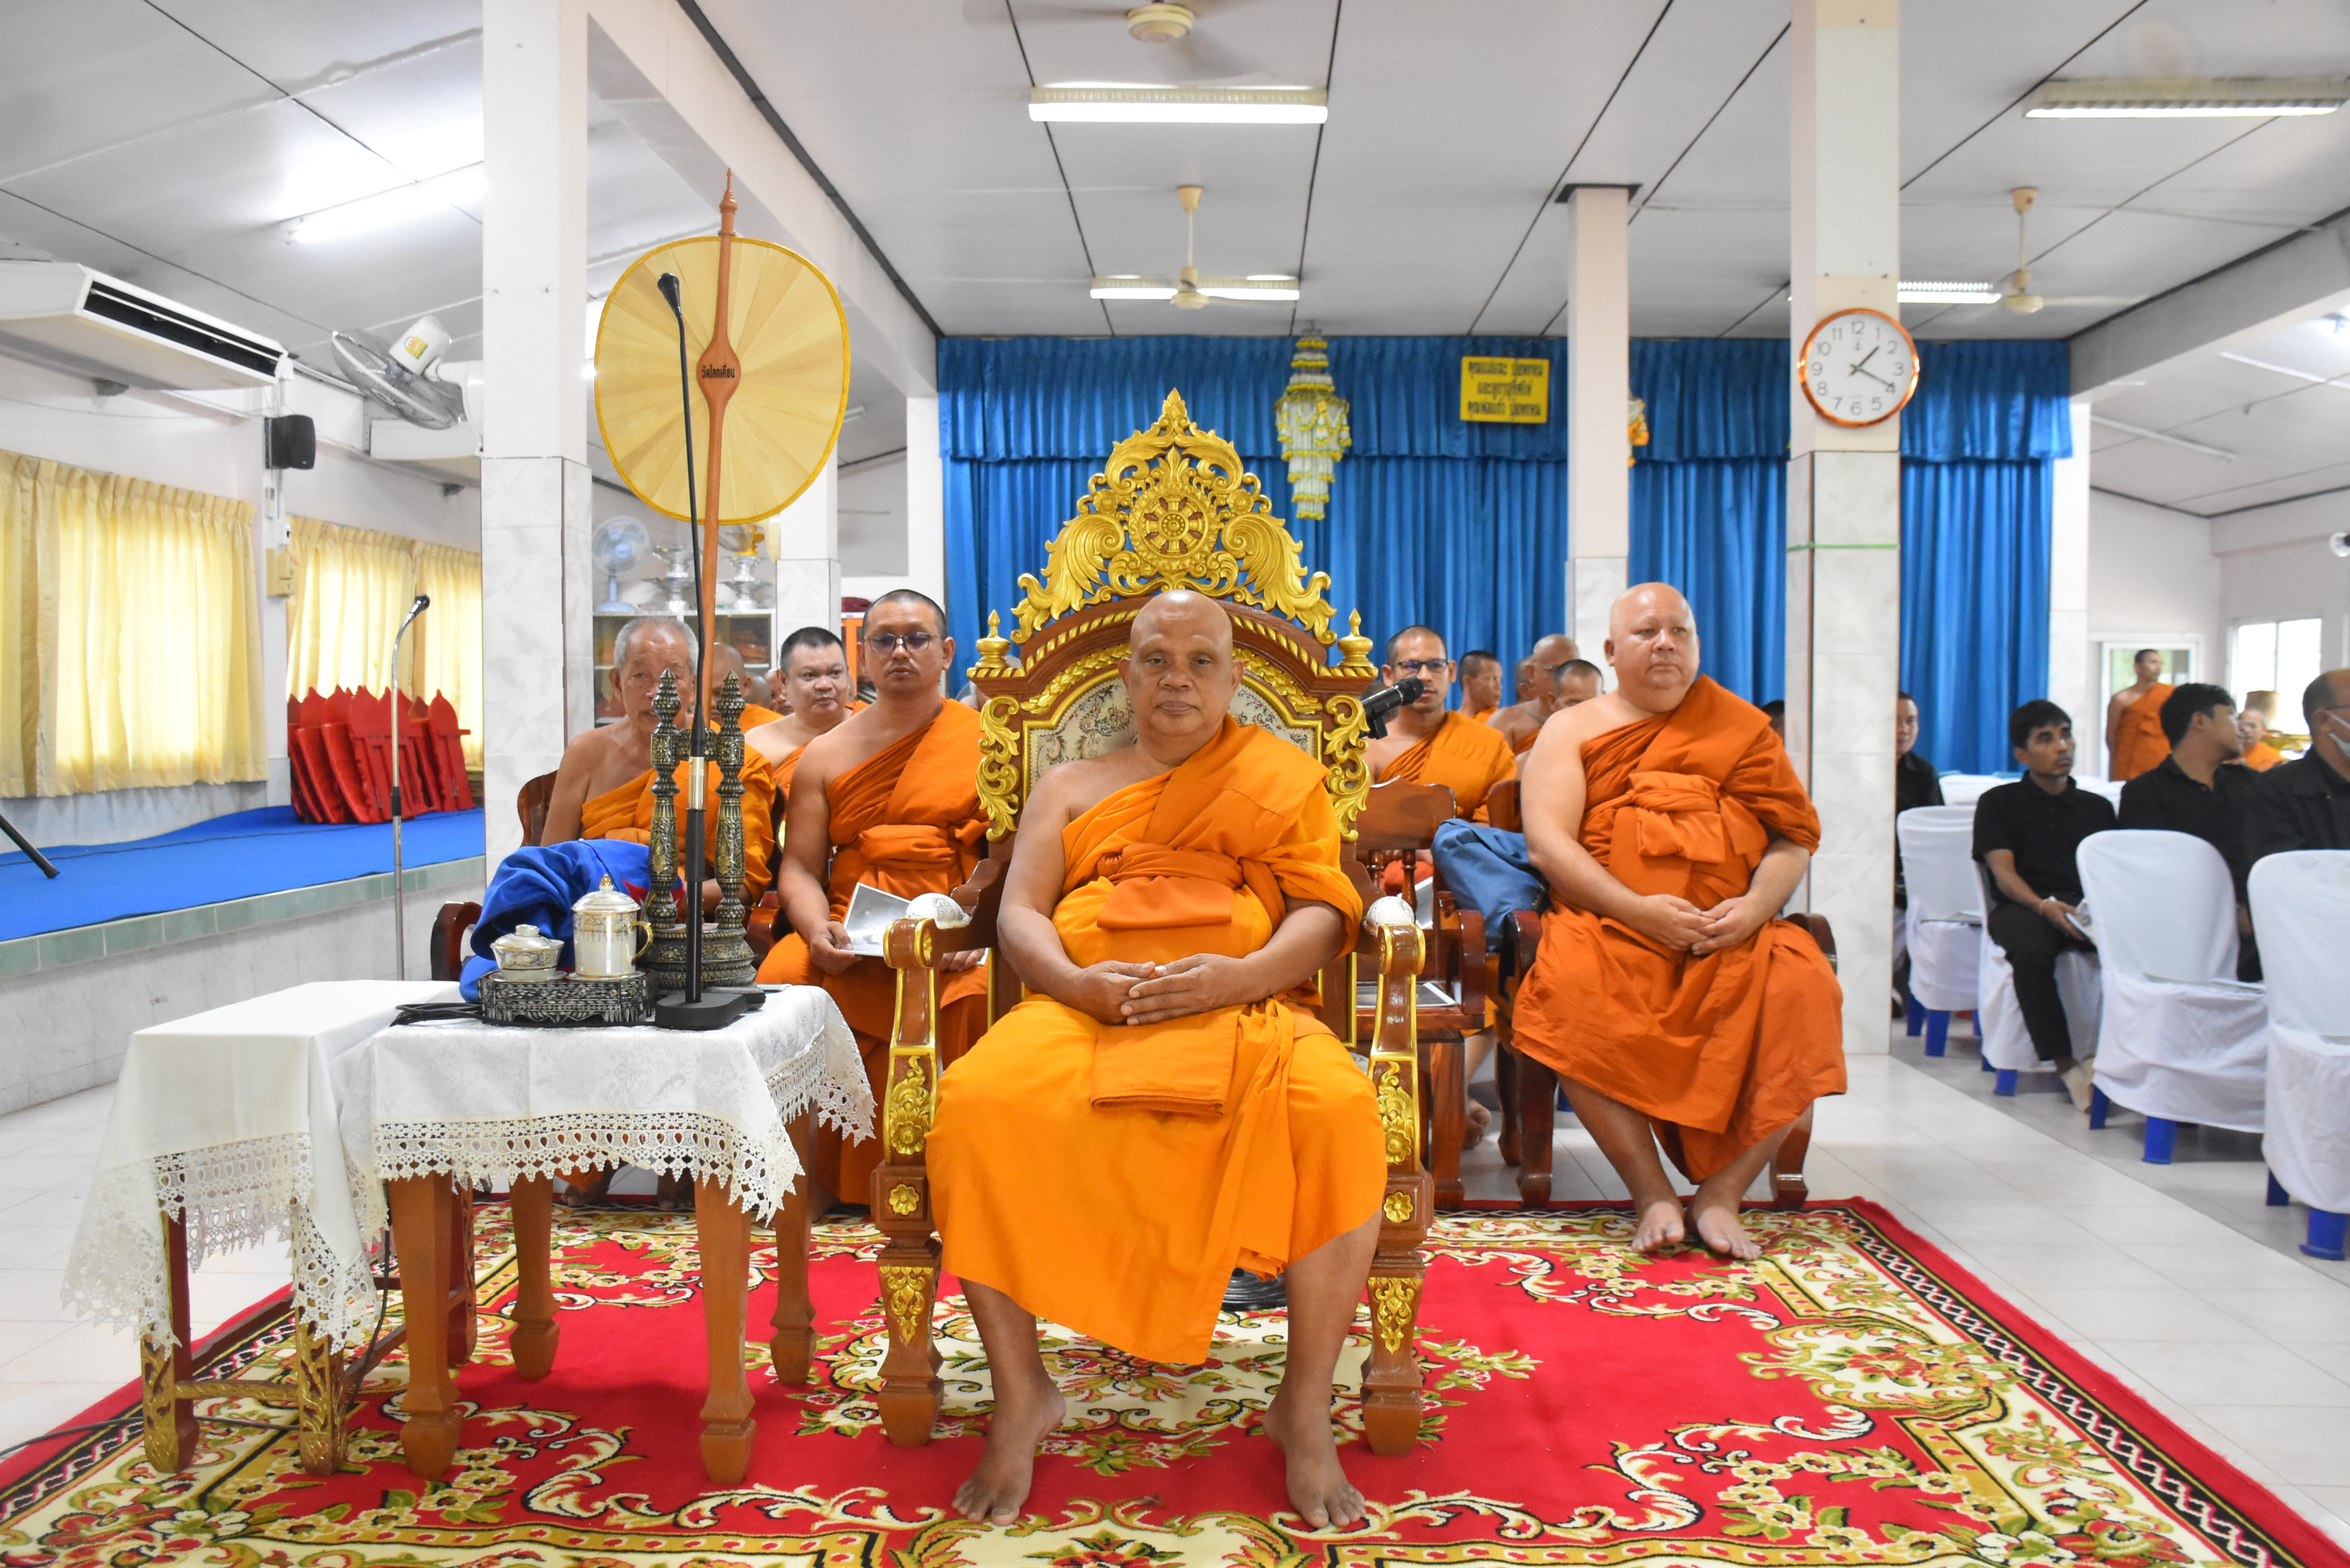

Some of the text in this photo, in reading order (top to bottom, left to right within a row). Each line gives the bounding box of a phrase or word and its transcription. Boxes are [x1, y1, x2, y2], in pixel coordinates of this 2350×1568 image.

[1832, 328, 1842, 340] 11
[1851, 321, 1864, 335] 12
[1876, 327, 1881, 340] 1
[1817, 341, 1831, 355] 10
[1887, 341, 1897, 354] 2
[1812, 362, 1823, 376] 9
[1893, 362, 1904, 376] 3
[1817, 381, 1827, 396] 8
[1885, 382, 1895, 394] 4
[1834, 397, 1842, 410] 7
[1850, 402, 1862, 416] 6
[1871, 397, 1882, 410] 5
